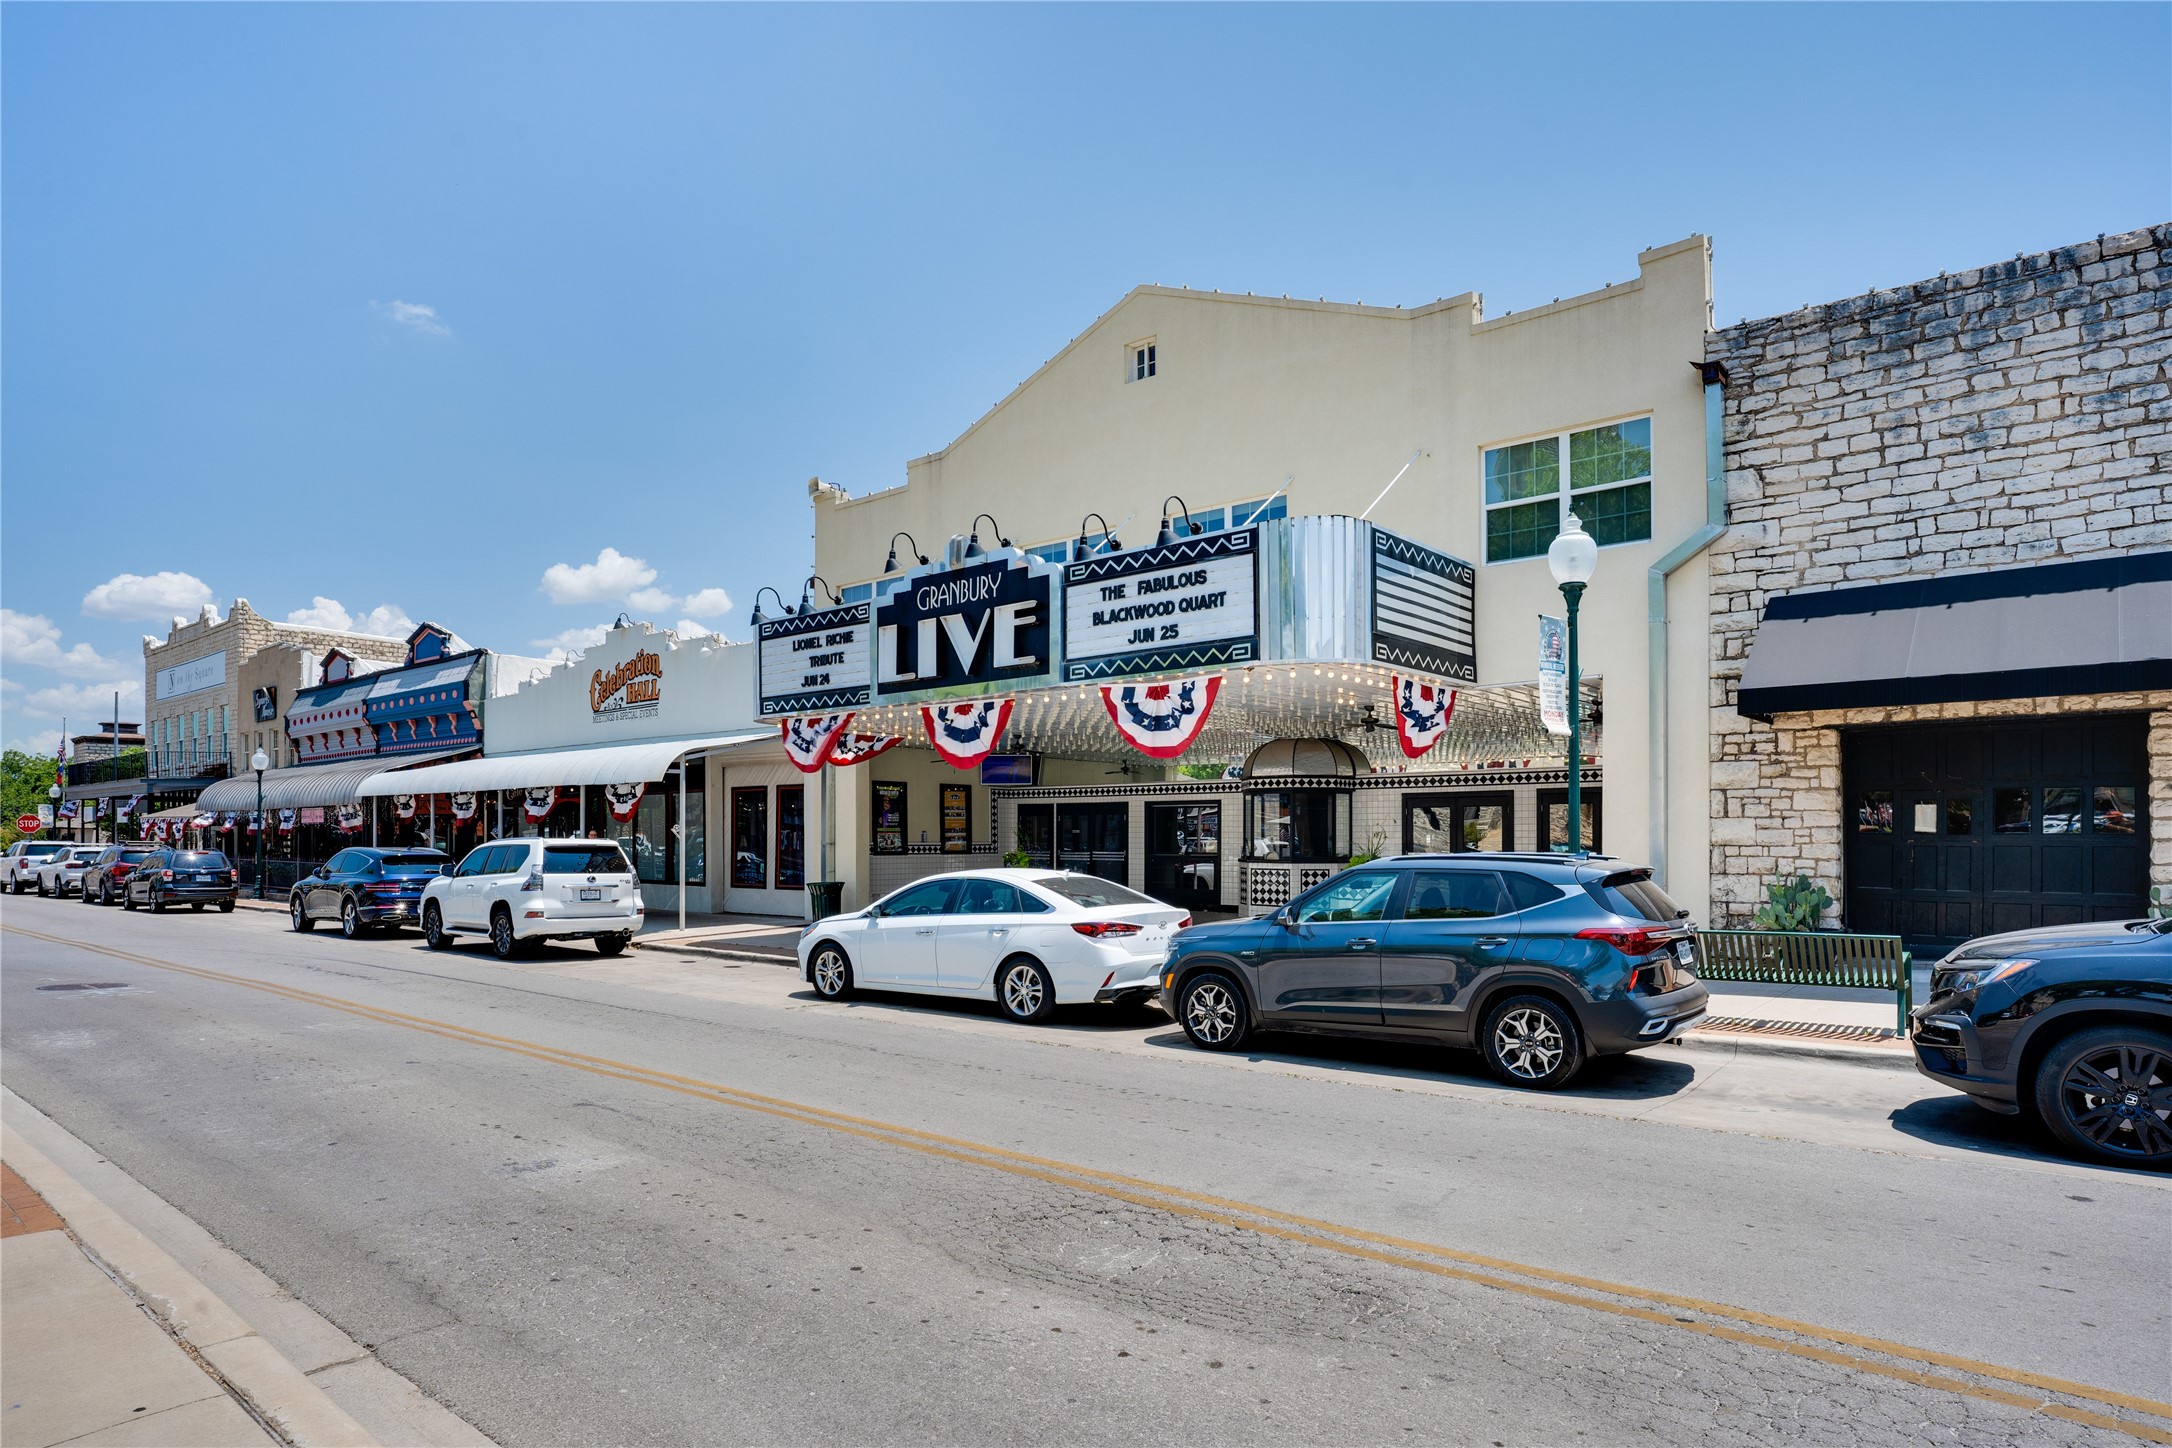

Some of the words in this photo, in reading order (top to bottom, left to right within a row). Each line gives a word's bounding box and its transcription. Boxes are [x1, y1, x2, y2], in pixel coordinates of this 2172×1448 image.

[917, 572, 1002, 611] GRANBURY
[1100, 584, 1126, 601] THE
[1137, 569, 1208, 595] FABULOUS
[1092, 600, 1176, 626] BLACKWOOD
[1178, 591, 1227, 613] QUART
[792, 636, 823, 652] LIONEL
[825, 630, 854, 647] RICHIE
[878, 599, 1038, 683] LIVE
[1128, 627, 1155, 644] JUN
[1160, 623, 1179, 641] 25
[809, 651, 845, 668] TRIBUTE
[195, 666, 214, 682] Square
[589, 648, 663, 713] Celebration
[801, 674, 818, 687] JUN
[819, 673, 830, 686] 24
[626, 679, 660, 704] HALL
[592, 712, 615, 724] MEETINGS
[619, 710, 639, 721] SPECIAL
[639, 708, 659, 719] EVENTS
[1543, 710, 1564, 718] MONDAY
[19, 820, 40, 828] STOP
